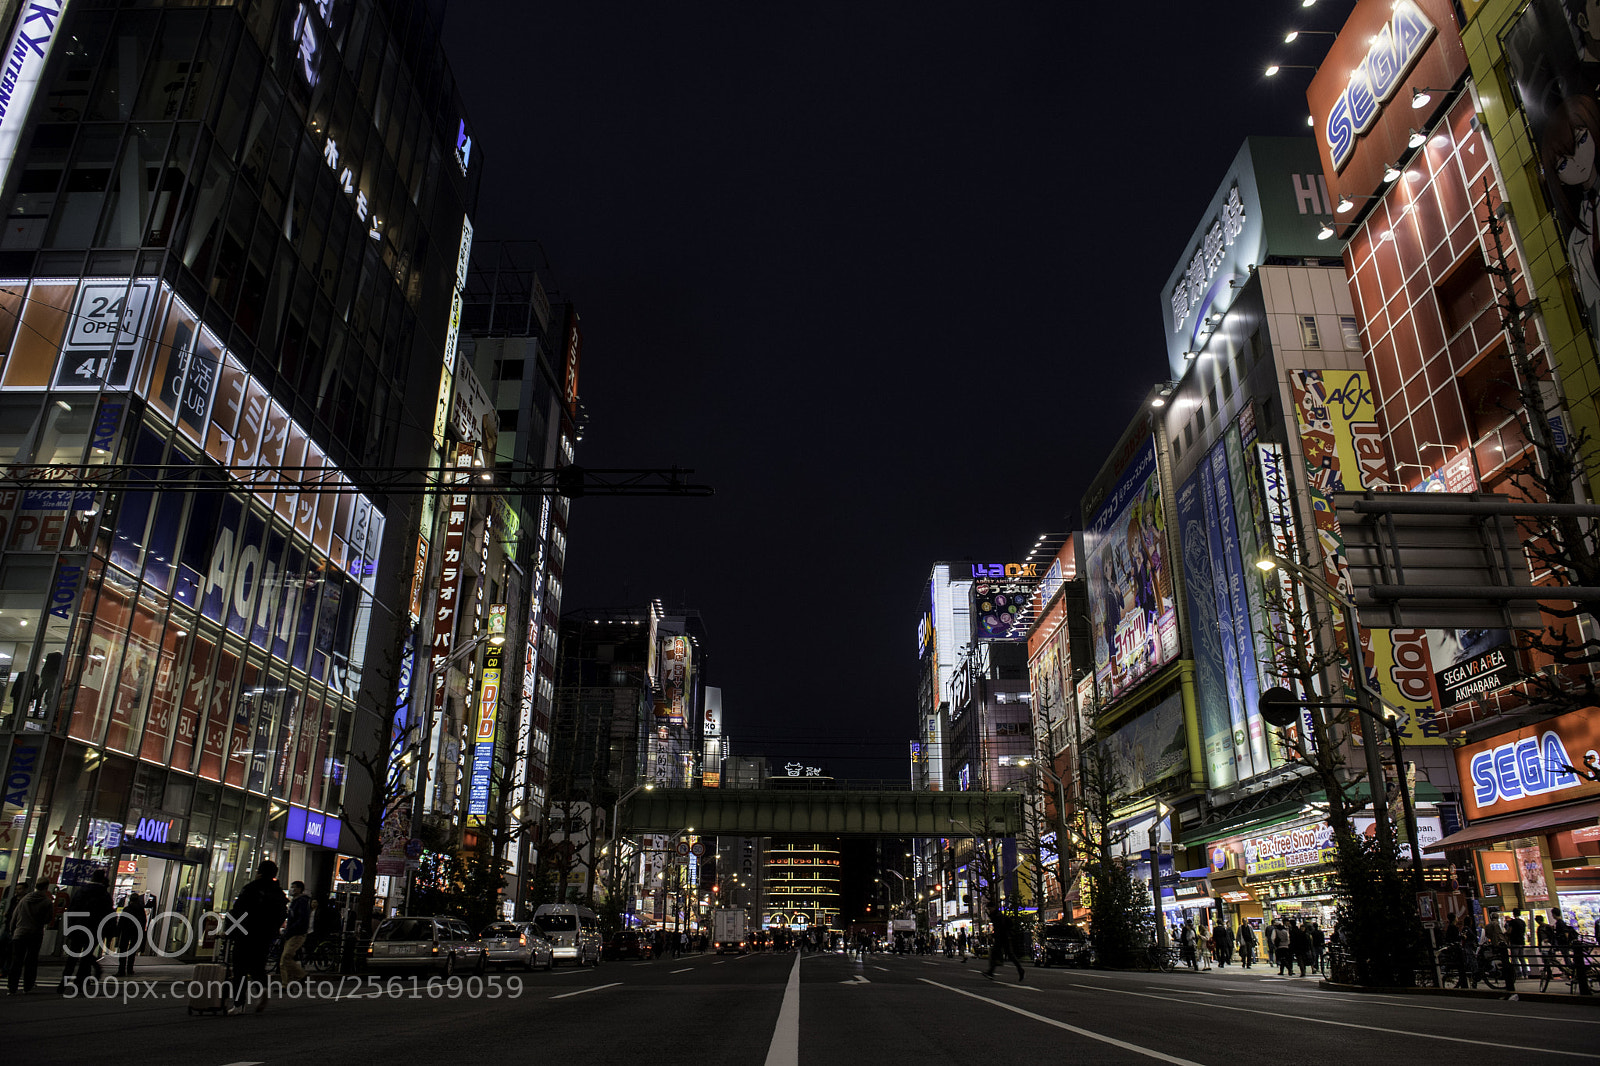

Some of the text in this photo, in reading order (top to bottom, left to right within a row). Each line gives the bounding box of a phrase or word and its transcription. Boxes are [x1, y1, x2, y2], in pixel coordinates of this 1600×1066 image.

[1326, 0, 1435, 172] SEGA
[324, 137, 381, 240] ホルモン
[83, 322, 131, 333] OPEN
[177, 343, 212, 395] 快活
[92, 403, 122, 451] AOKI
[50, 565, 81, 619] AOKI
[207, 527, 296, 642] AOKI
[486, 647, 502, 655] アニメ
[1115, 612, 1146, 662] コイカツ!
[488, 658, 498, 667] CD
[1443, 650, 1505, 687] SEGA VR AREA
[478, 684, 498, 738] DVD
[1455, 674, 1501, 702] AKIHABARA
[4, 748, 37, 808] AOKI
[1470, 730, 1582, 809] SEGA
[136, 817, 169, 844] AOKI
[306, 821, 321, 837] AOKI
[1293, 830, 1315, 850] Shop
